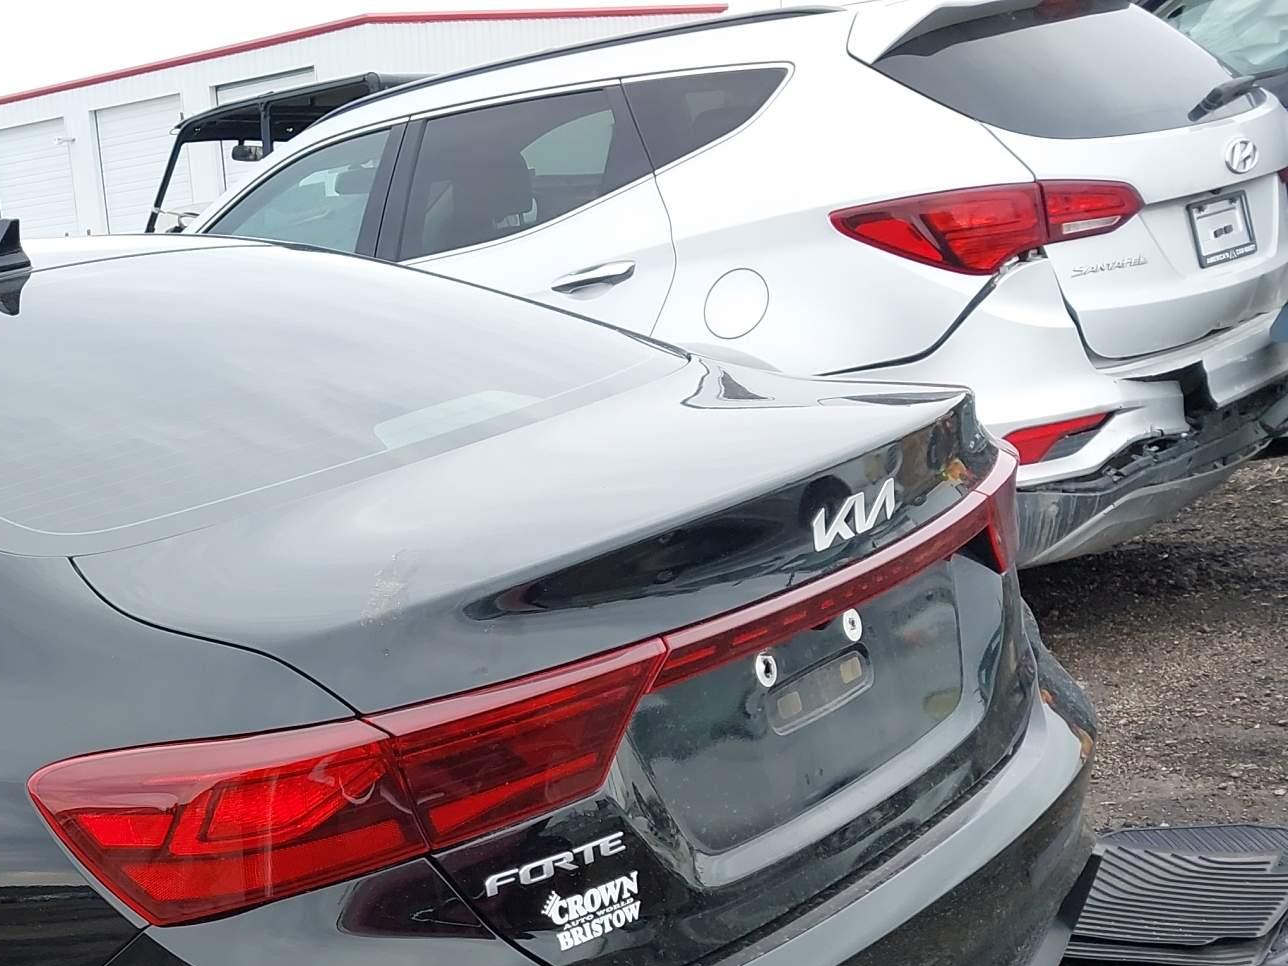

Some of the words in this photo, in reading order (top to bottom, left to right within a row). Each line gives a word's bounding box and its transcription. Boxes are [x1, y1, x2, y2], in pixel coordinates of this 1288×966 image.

[812, 477, 896, 552] KIA
[485, 831, 627, 898] FORTE
[549, 870, 639, 926] CROWN
[556, 900, 642, 951] BRISTOW
[563, 913, 595, 931] AUTO
[597, 897, 635, 915] WORLD
